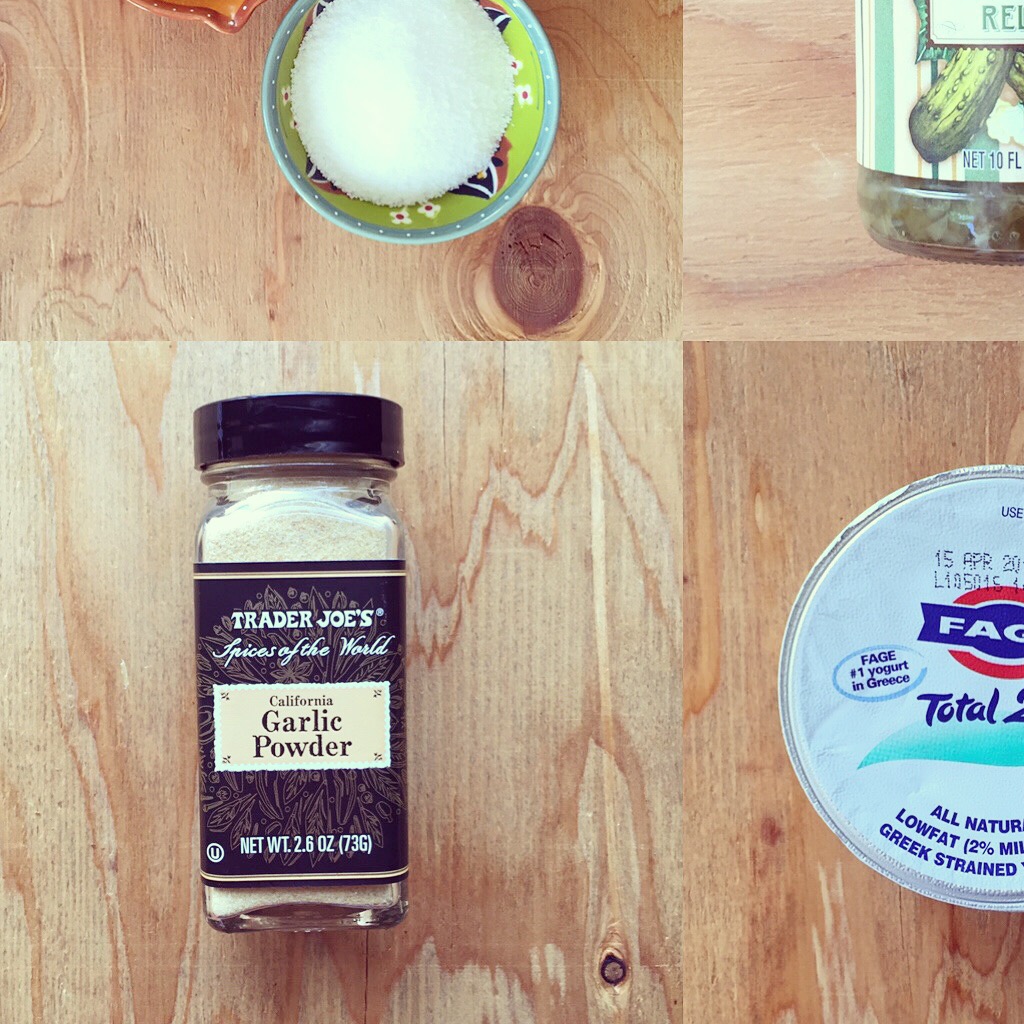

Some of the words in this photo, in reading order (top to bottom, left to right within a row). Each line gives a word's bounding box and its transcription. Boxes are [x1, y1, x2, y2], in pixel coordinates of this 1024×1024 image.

[963, 150, 985, 169] NET
[989, 150, 1004, 169] 10
[1008, 150, 1023, 170] FL
[1001, 506, 1024, 520] USE
[934, 549, 954, 569] 15
[963, 552, 993, 571] APR
[231, 611, 313, 630] TRADER
[213, 638, 276, 668] Spices
[277, 637, 304, 666] of
[300, 637, 330, 657] the
[339, 634, 396, 657] World
[861, 649, 897, 667] FAGE
[850, 667, 865, 680] #1
[867, 660, 909, 679] yogurt
[851, 679, 866, 693] in
[867, 672, 911, 690] Greece
[269, 694, 334, 707] California
[916, 688, 999, 727] Total
[261, 709, 343, 733] Garlic
[252, 734, 352, 758] Powder
[930, 804, 960, 829] ALL
[896, 807, 959, 850] LOWFAT
[963, 837, 995, 856] (2%
[240, 837, 265, 854] NET
[267, 836, 292, 854] WT.
[293, 836, 315, 853] 2.6
[317, 835, 335, 853] OZ
[338, 834, 373, 856] (73G)
[879, 822, 931, 862] GREEK
[934, 851, 1017, 877] STRAINED
